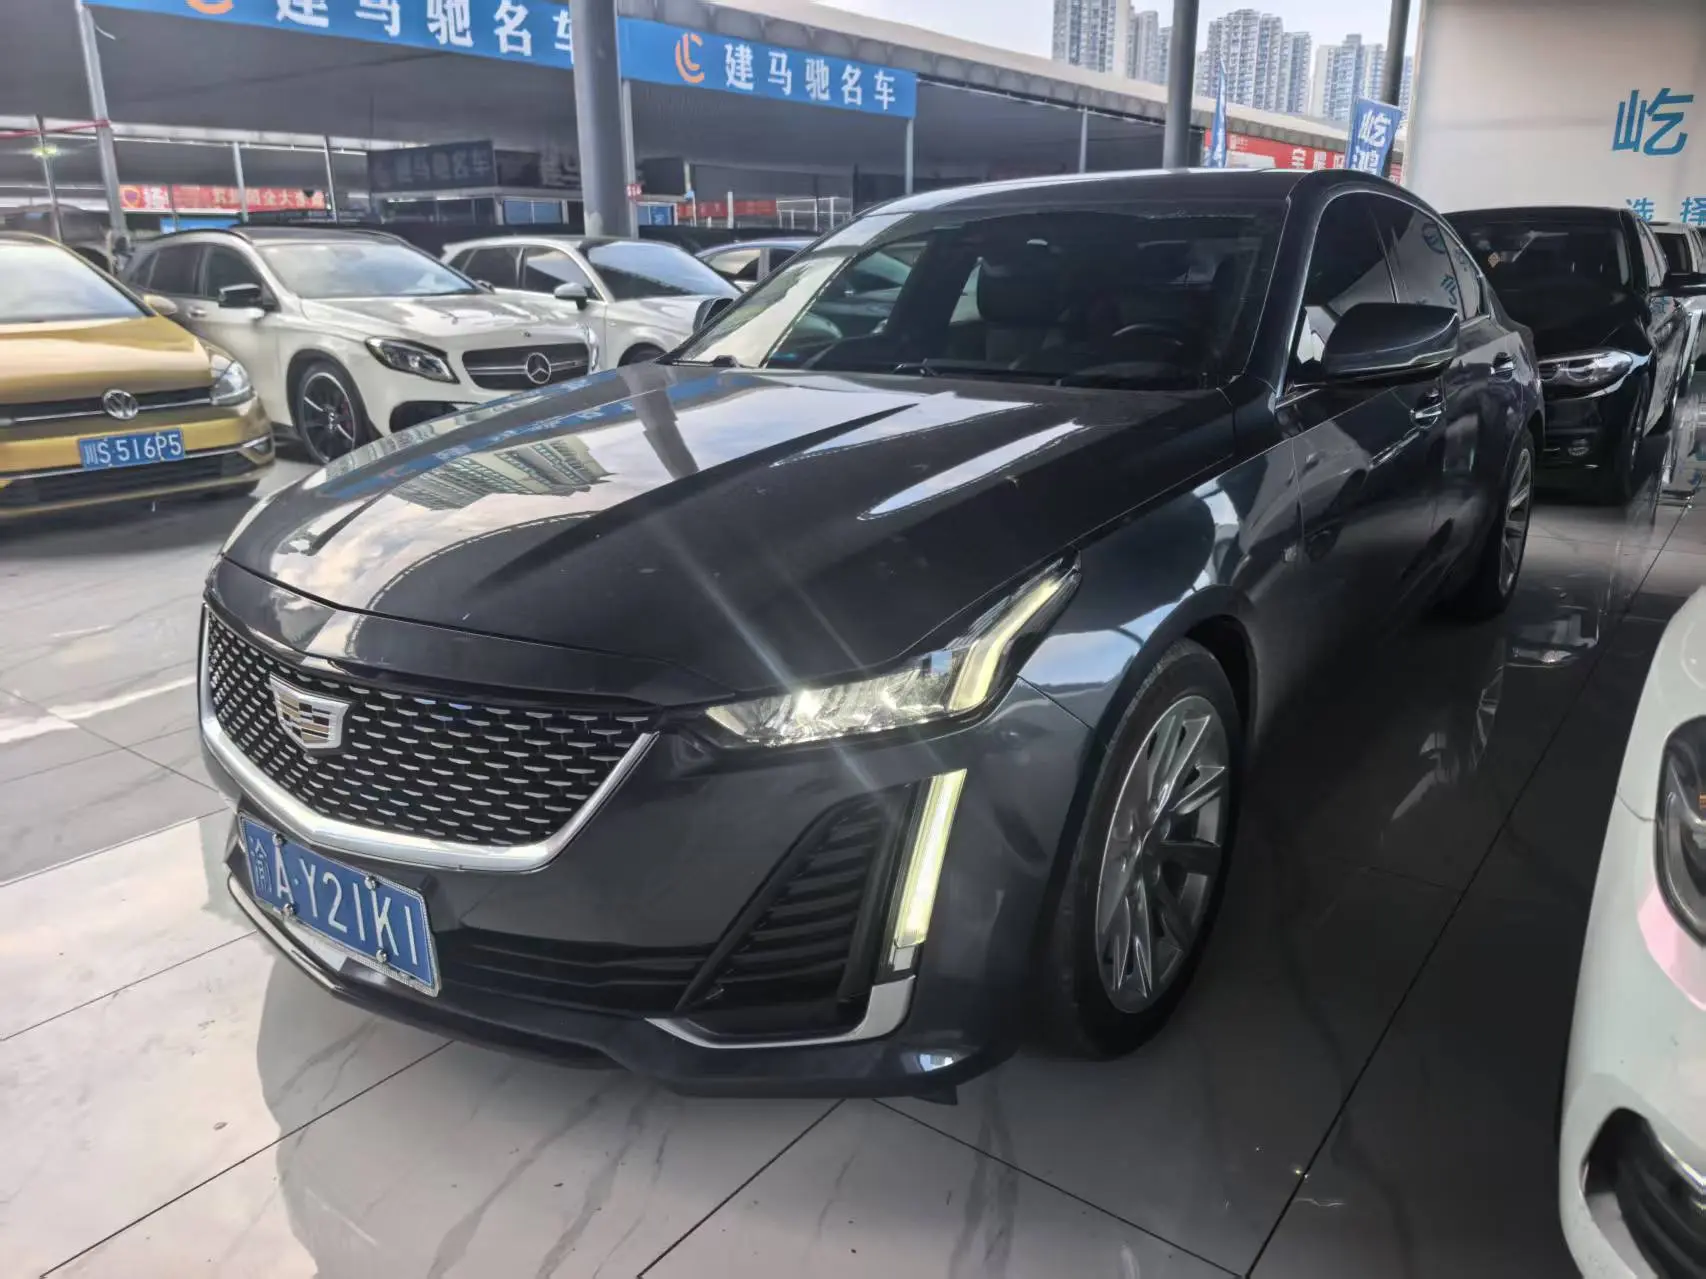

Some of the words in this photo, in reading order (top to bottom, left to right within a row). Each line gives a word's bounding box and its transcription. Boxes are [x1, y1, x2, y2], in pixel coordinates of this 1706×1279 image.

[725, 42, 896, 111] 建马驰名车
[1611, 87, 1696, 156] 屹
